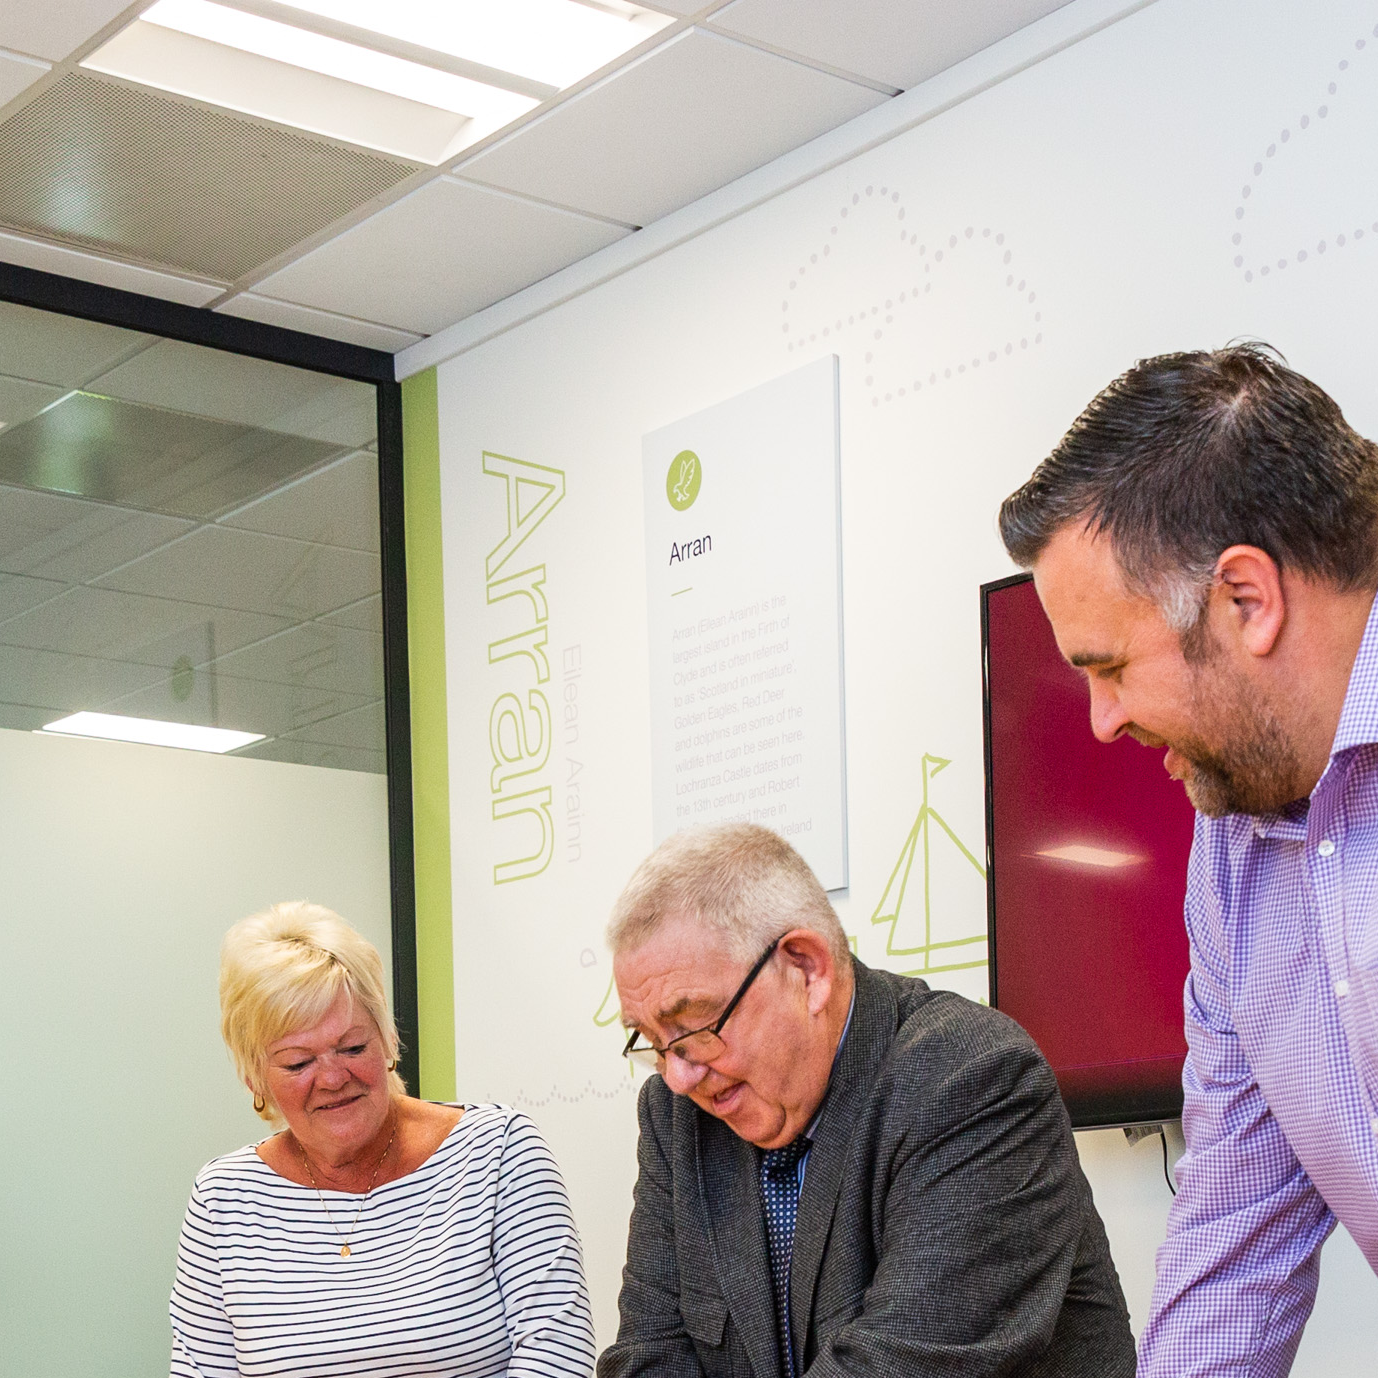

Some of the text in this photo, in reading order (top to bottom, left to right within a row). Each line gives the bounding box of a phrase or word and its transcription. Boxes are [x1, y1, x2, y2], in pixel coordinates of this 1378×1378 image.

[668, 533, 713, 566] Arran
[672, 594, 787, 641] Arran (Eilean Arainn) is the
[672, 613, 790, 664] largest island in the Firth of
[481, 449, 566, 885] Arran
[673, 637, 789, 687] Clyde and is often referred
[673, 696, 683, 708] to
[684, 693, 695, 705] as
[740, 675, 749, 688] in
[674, 710, 706, 730] Golden
[742, 694, 761, 710] Red
[762, 688, 785, 704] Deer
[675, 705, 803, 752] and dolphins are some of the
[675, 728, 805, 774] wildlife that can be seen here.
[562, 643, 585, 864] Eilean Arainn
[676, 752, 803, 796] Lochranza Castle dates from
[676, 775, 800, 818] the 13th century and Robert
[753, 804, 778, 821] there
[778, 801, 788, 815] in
